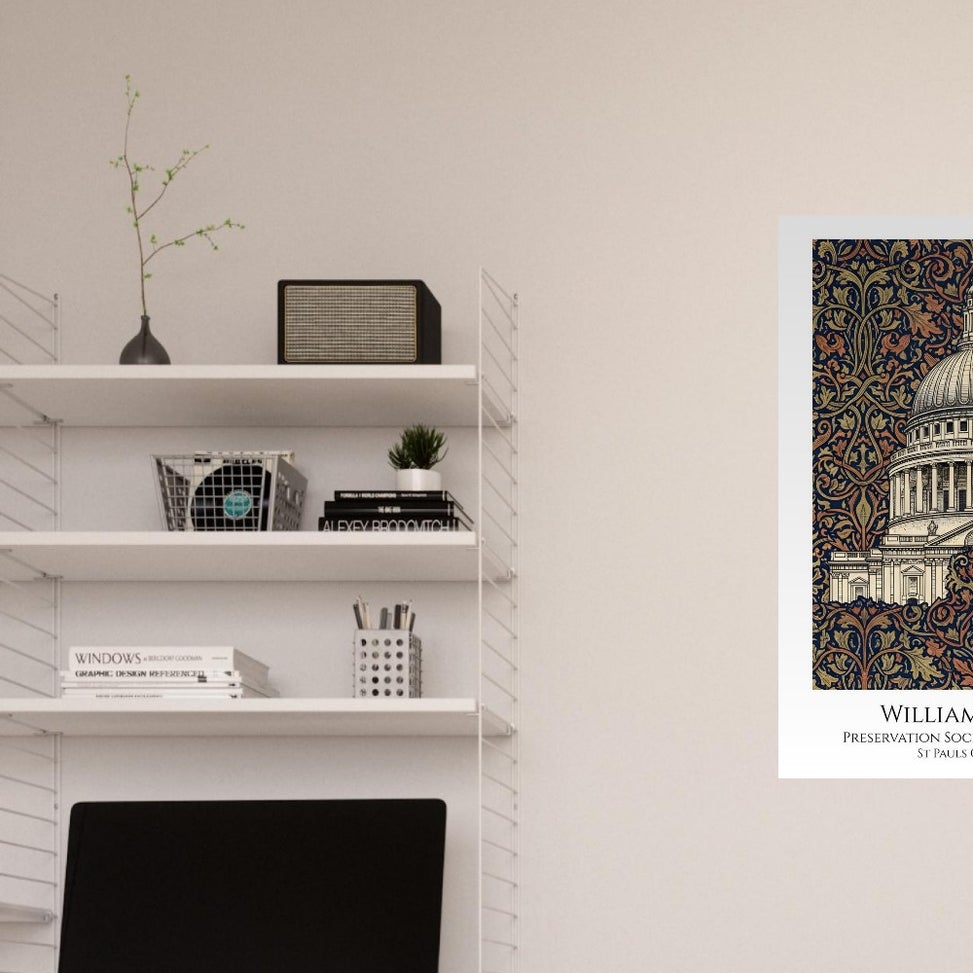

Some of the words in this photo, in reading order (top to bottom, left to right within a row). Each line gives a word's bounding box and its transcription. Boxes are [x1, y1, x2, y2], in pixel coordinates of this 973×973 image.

[322, 519, 369, 531] ALEXEY
[75, 652, 142, 664] WINDOWS
[843, 731, 941, 744] PRESERVATION
[933, 748, 968, 759] PAULS
